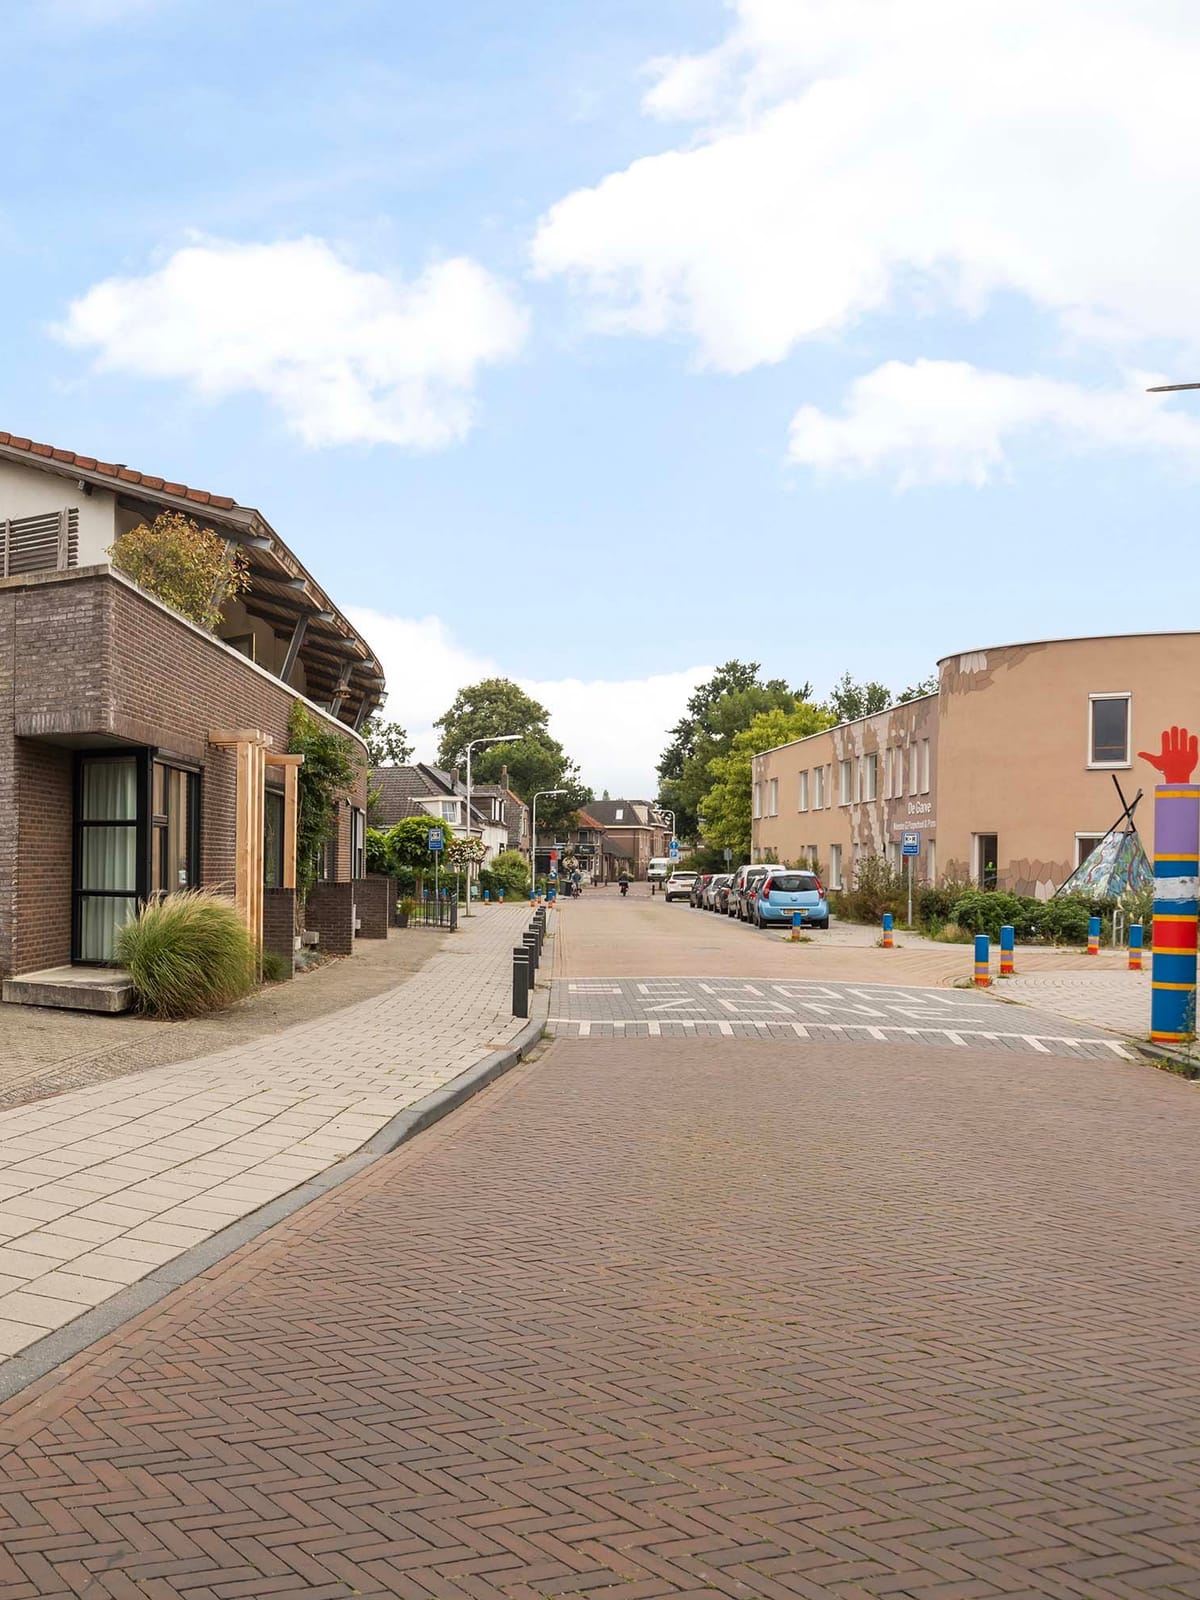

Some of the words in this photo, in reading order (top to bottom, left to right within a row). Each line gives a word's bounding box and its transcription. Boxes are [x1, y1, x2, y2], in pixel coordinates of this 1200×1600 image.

[907, 802, 915, 814] De
[568, 983, 1000, 1007] SCHOOL
[636, 998, 984, 1023] ZONE
